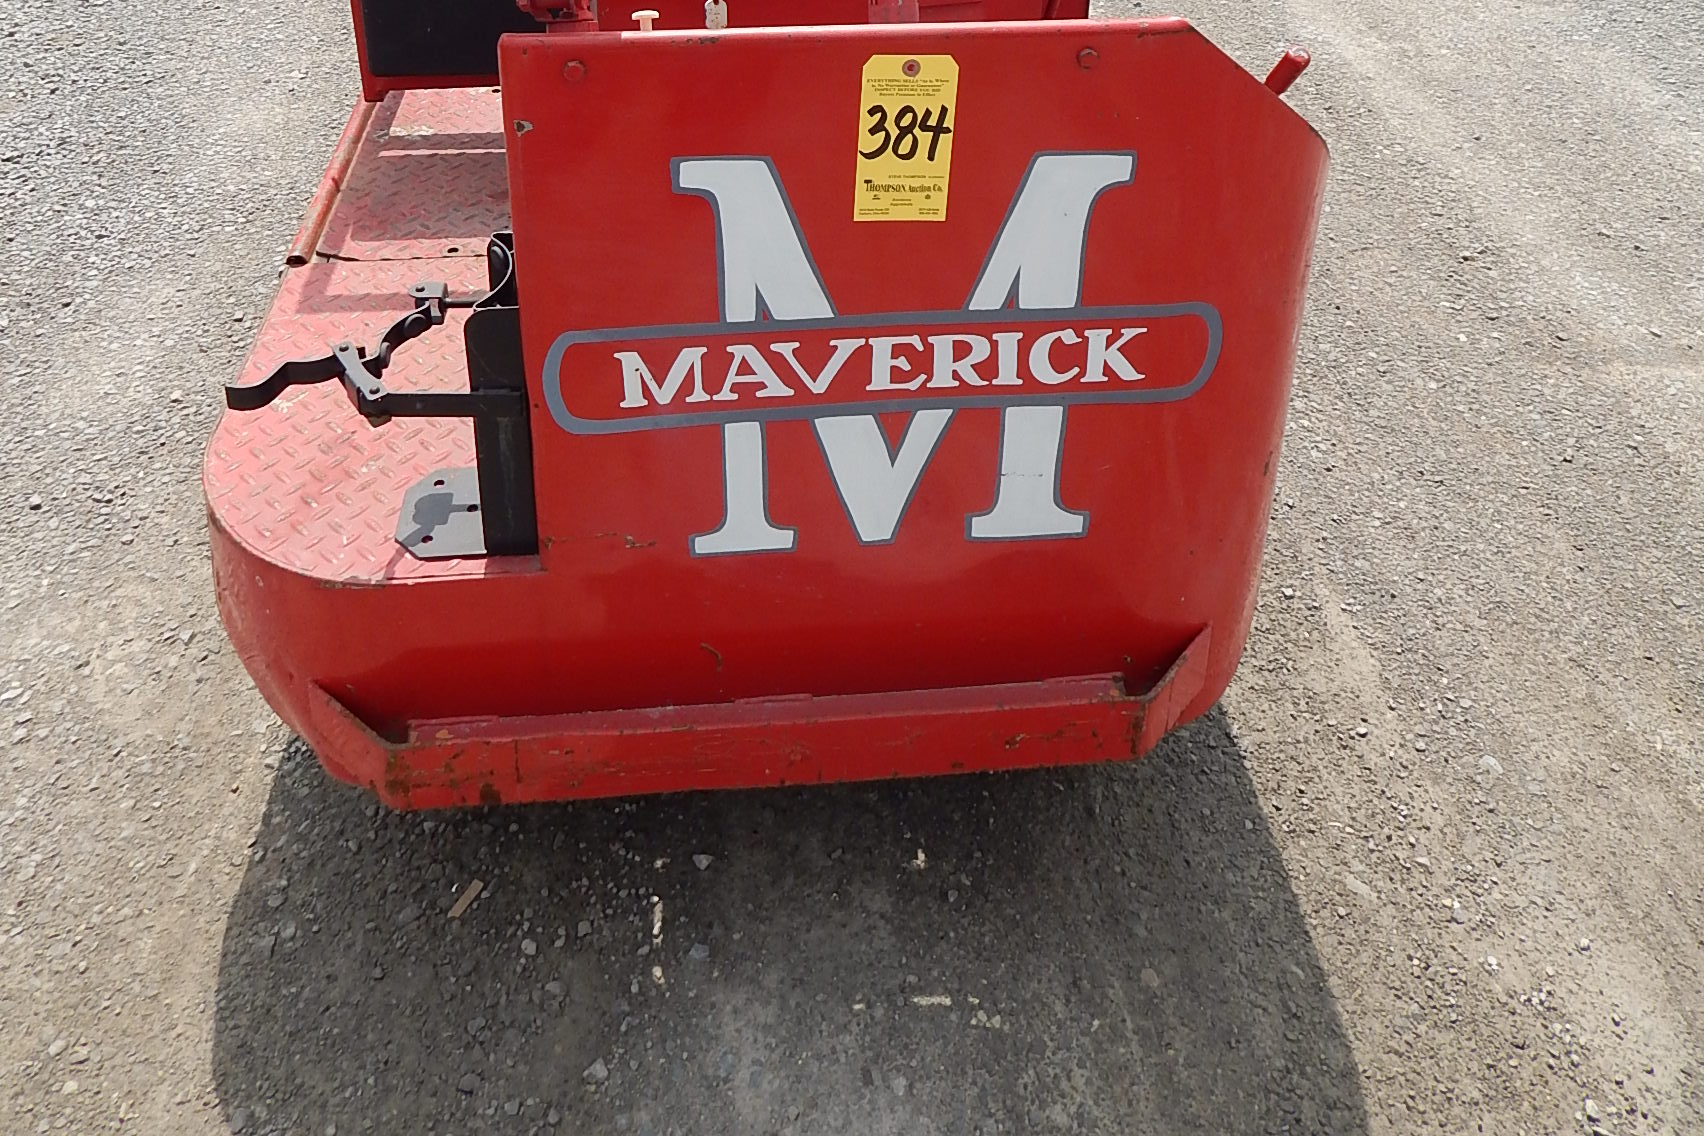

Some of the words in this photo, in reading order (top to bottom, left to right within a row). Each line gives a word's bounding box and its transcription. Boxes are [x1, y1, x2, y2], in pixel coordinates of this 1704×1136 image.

[859, 104, 952, 162] 384
[864, 179, 907, 193] THOMPSON
[909, 183, 932, 193] Auction
[613, 327, 1147, 408] MAVERICK
[672, 152, 1135, 555] M
